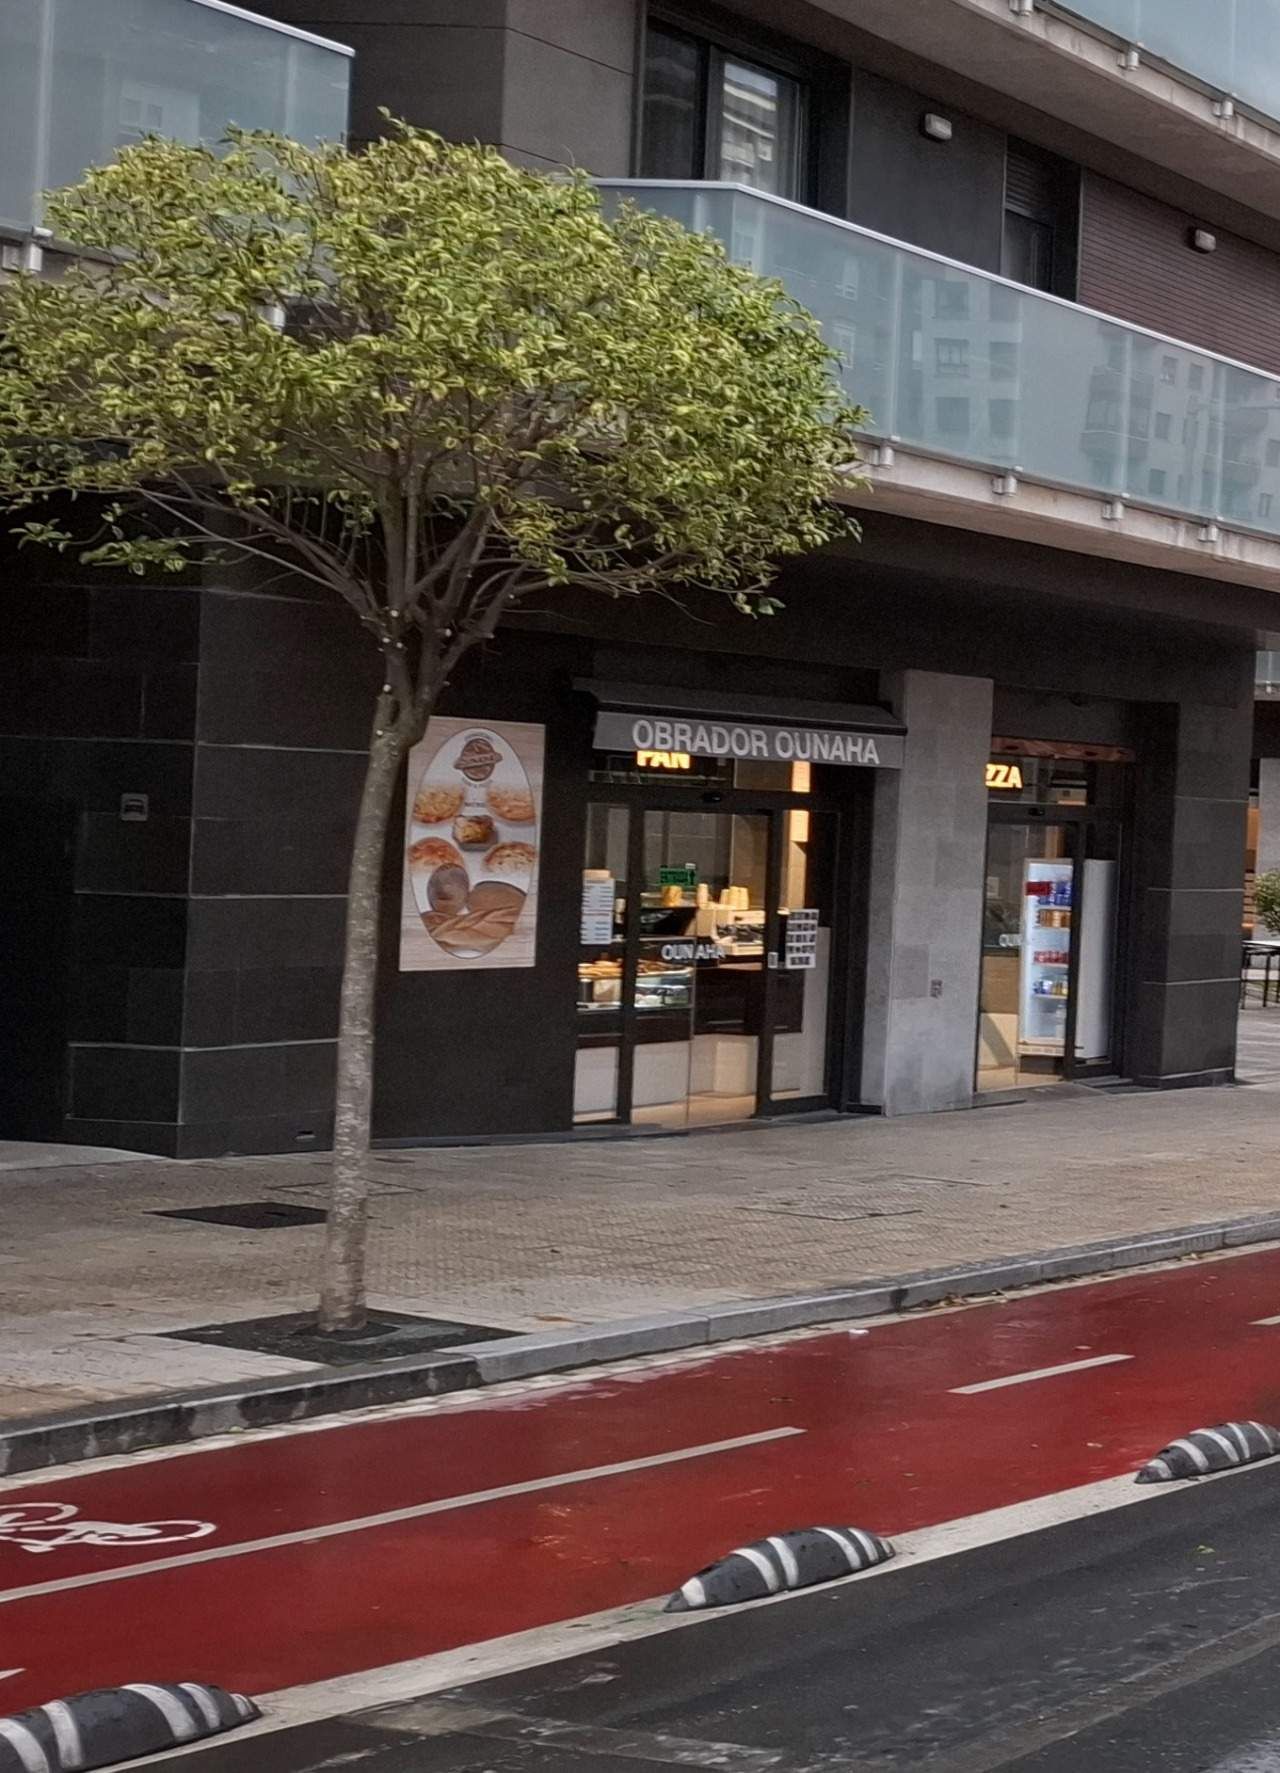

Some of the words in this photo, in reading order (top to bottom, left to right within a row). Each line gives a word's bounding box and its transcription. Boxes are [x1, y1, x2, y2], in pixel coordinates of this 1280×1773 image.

[632, 719, 769, 757] OBRADOR
[775, 730, 880, 764] OUNAHA
[636, 750, 691, 769] PAN
